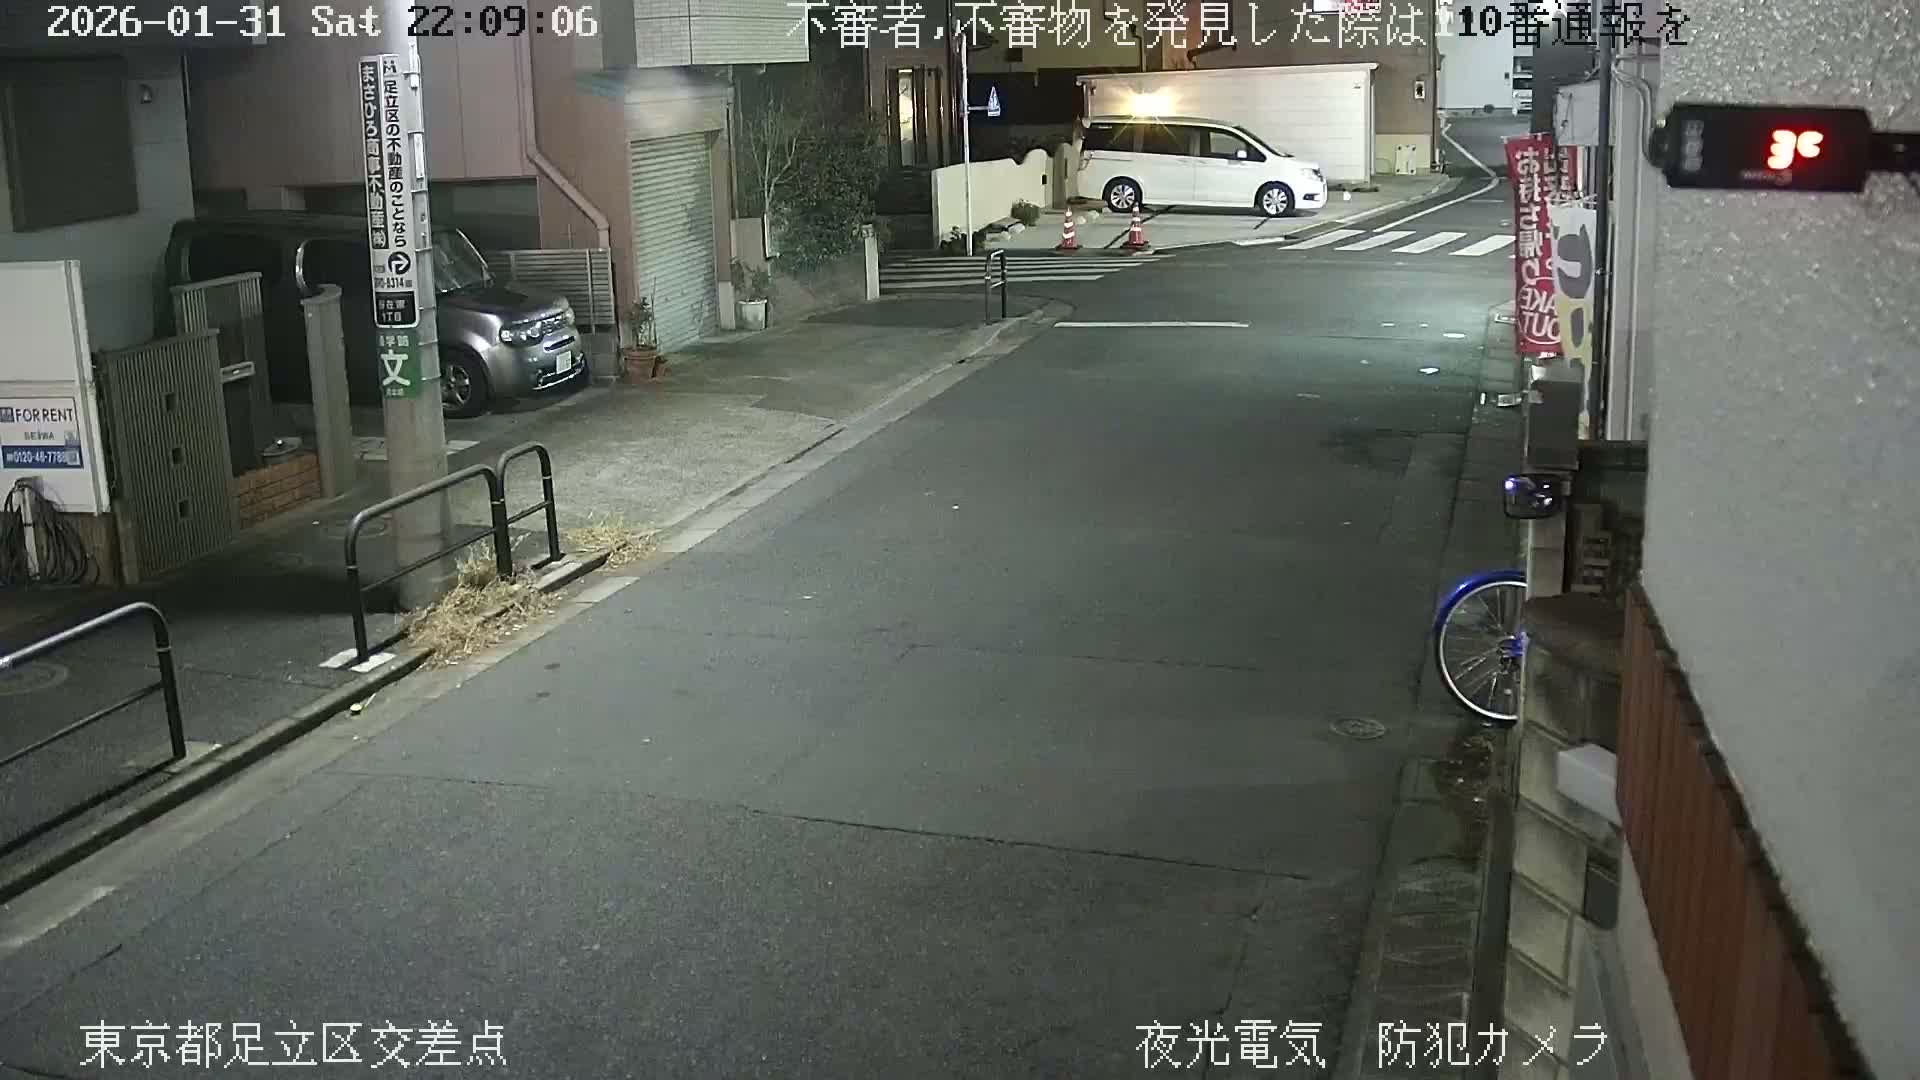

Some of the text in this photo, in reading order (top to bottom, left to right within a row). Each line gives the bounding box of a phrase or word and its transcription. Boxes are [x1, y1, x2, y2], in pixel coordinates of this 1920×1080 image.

[383, 80, 407, 247] 足立区の不動産のことなら
[380, 349, 411, 386] 文
[16, 408, 41, 422] FOR
[43, 408, 73, 422] RENT
